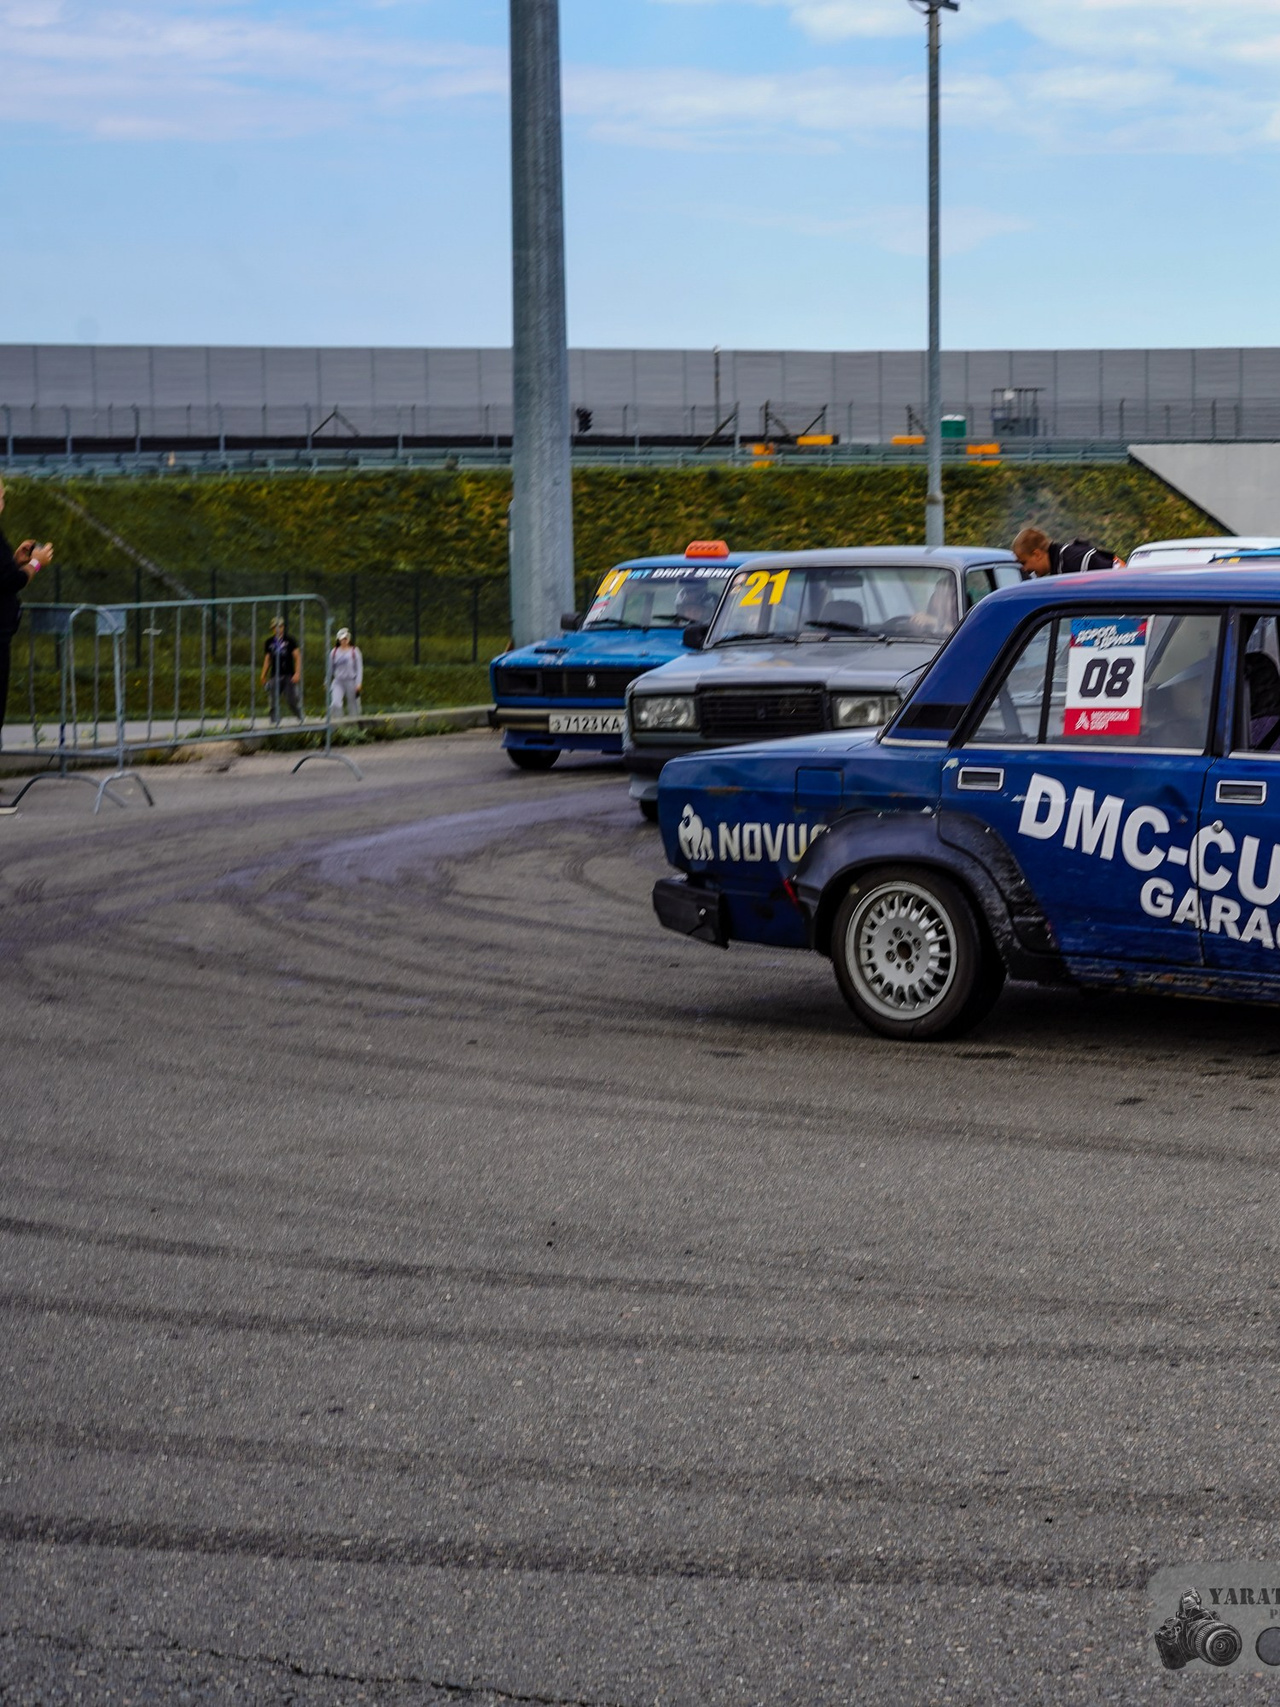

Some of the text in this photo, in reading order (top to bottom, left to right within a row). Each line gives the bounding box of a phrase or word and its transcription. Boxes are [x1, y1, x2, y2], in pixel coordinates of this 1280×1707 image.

[651, 567, 695, 579] DRIFT
[739, 569, 790, 607] 21
[1080, 658, 1135, 698] 08
